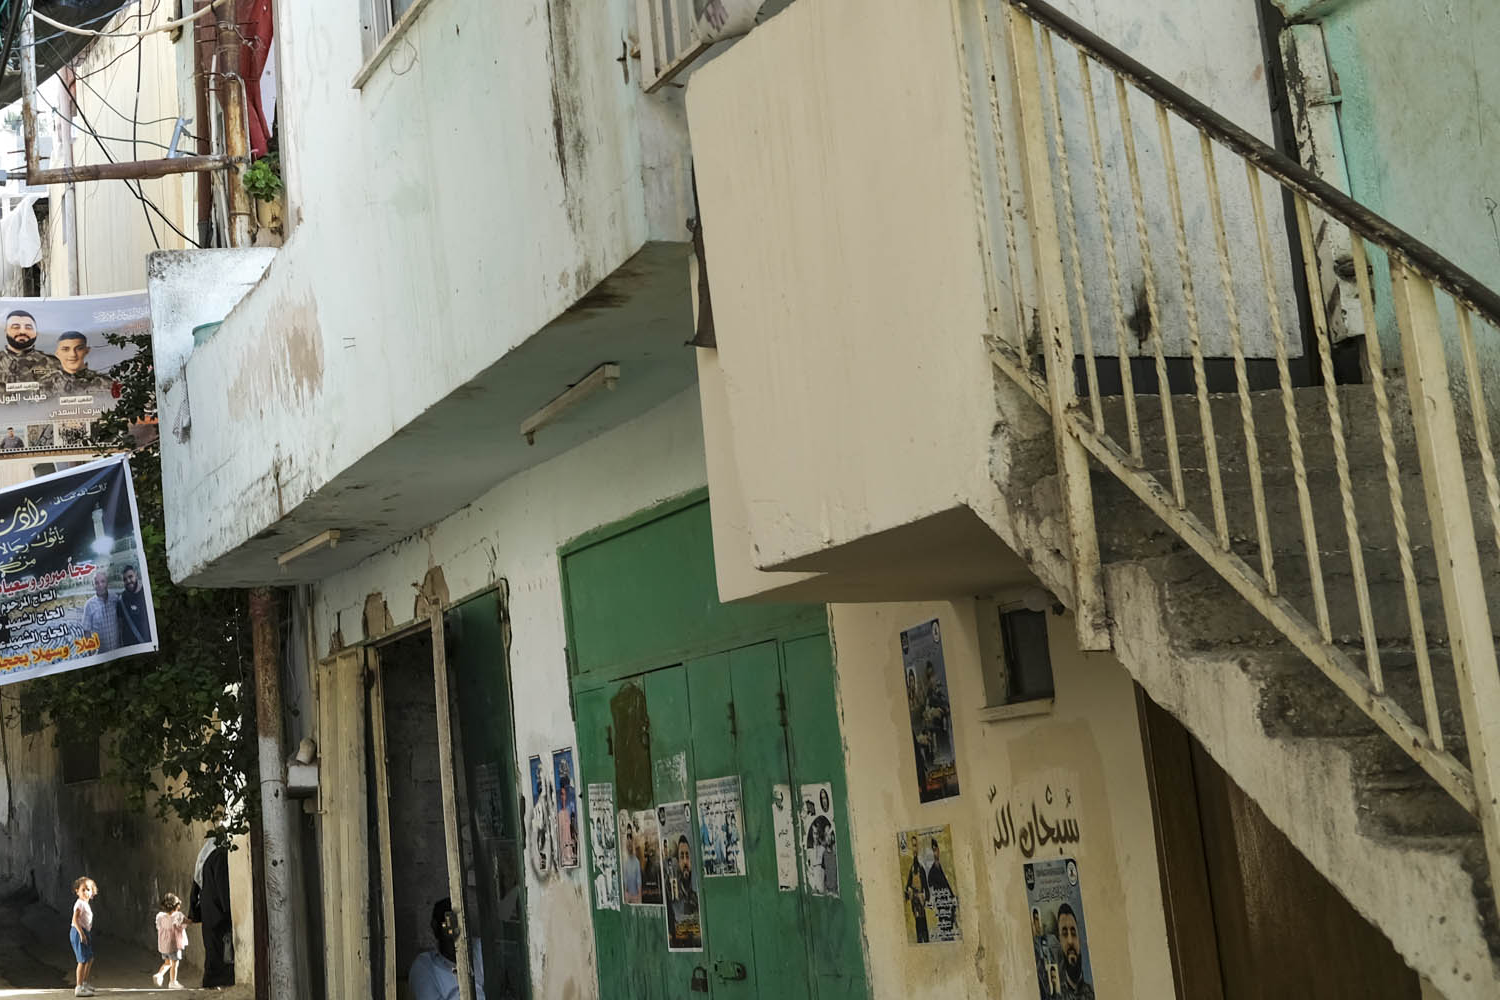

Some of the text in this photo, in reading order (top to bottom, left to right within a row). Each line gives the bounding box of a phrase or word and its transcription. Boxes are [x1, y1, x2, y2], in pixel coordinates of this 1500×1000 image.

[39, 570, 67, 588] مبرور
[1, 595, 31, 615] المرحوم
[33, 590, 57, 607] الحاج
[5, 612, 36, 631] الشهيد
[37, 606, 65, 625] الحاج
[9, 631, 39, 649] الشهيد
[40, 624, 68, 642] الحاج
[31, 645, 69, 664] وسهلا
